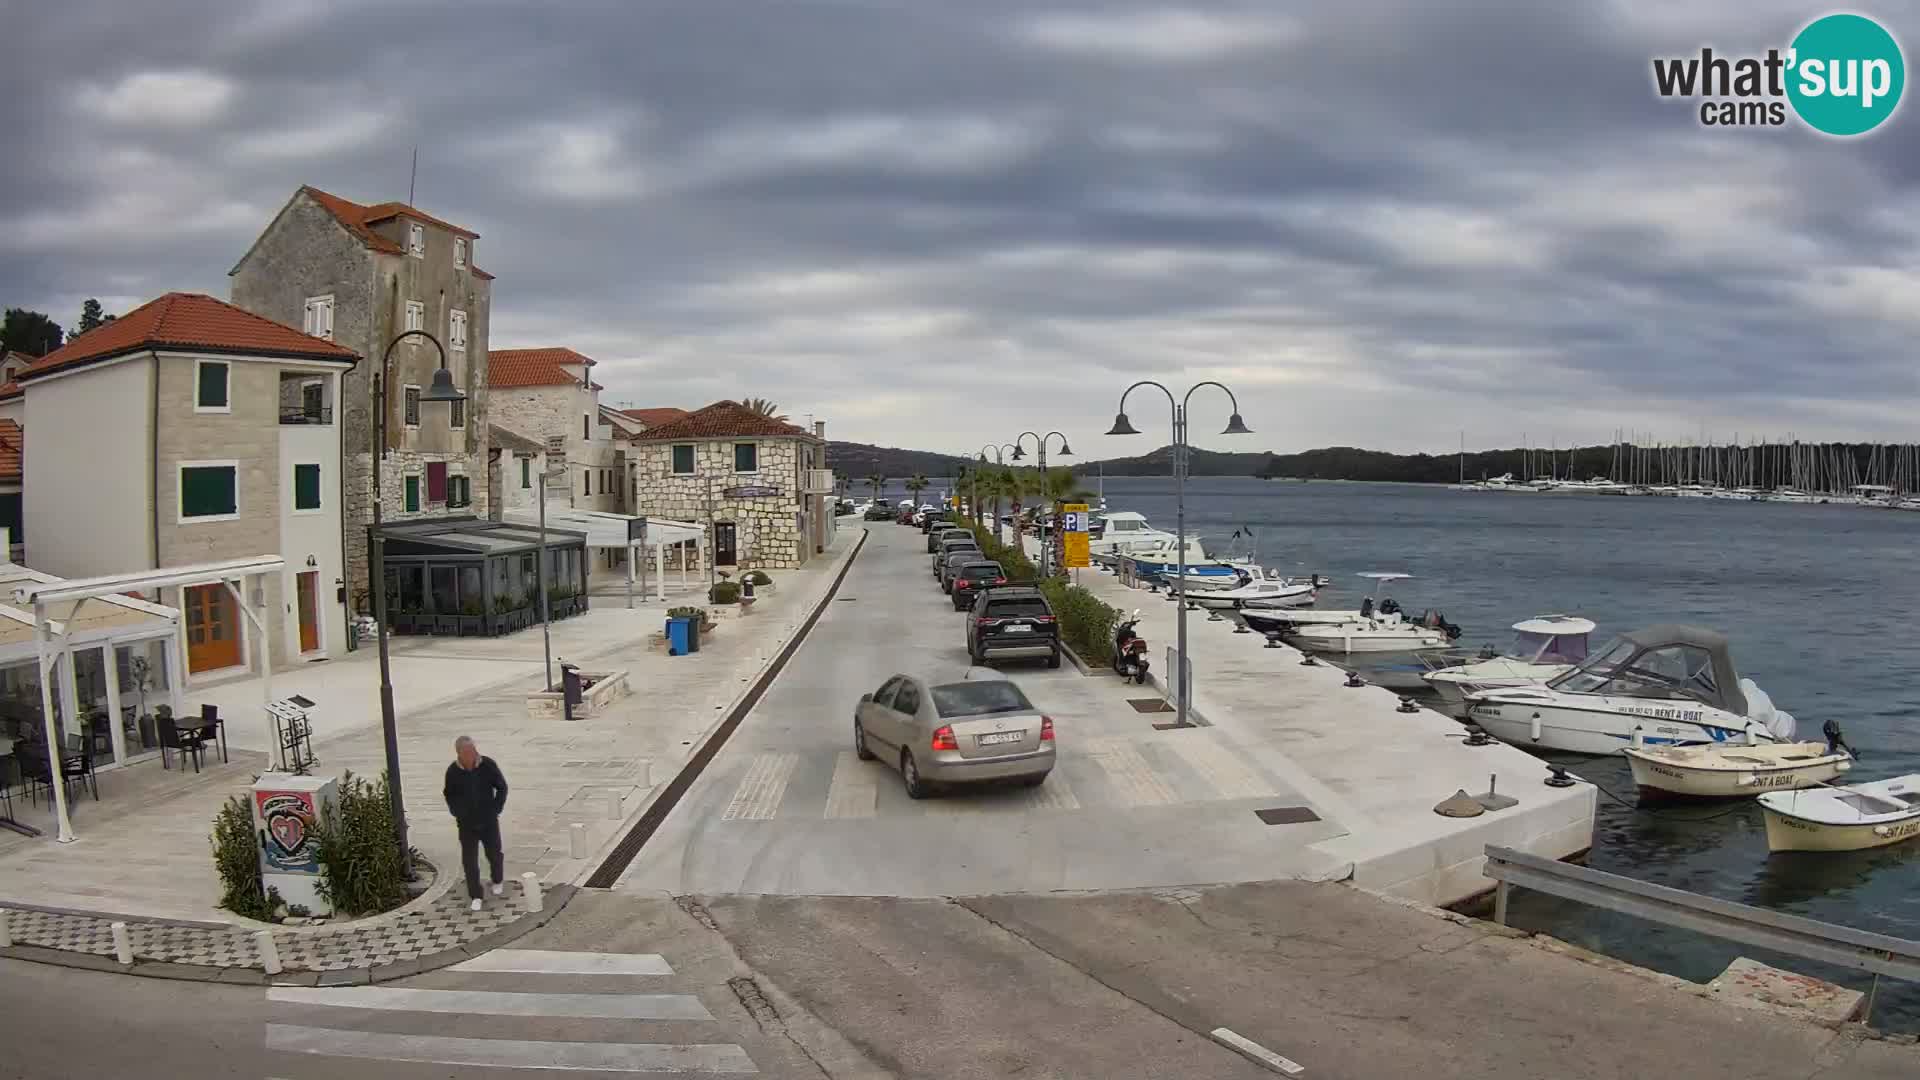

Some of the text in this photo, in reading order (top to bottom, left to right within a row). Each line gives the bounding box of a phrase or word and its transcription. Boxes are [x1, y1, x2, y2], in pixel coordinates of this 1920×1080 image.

[1066, 514, 1076, 530] P
[1655, 708, 1675, 718] RENT
[1683, 711, 1703, 721] BOAT
[1768, 776, 1774, 786] A
[1775, 774, 1794, 786] BOAT
